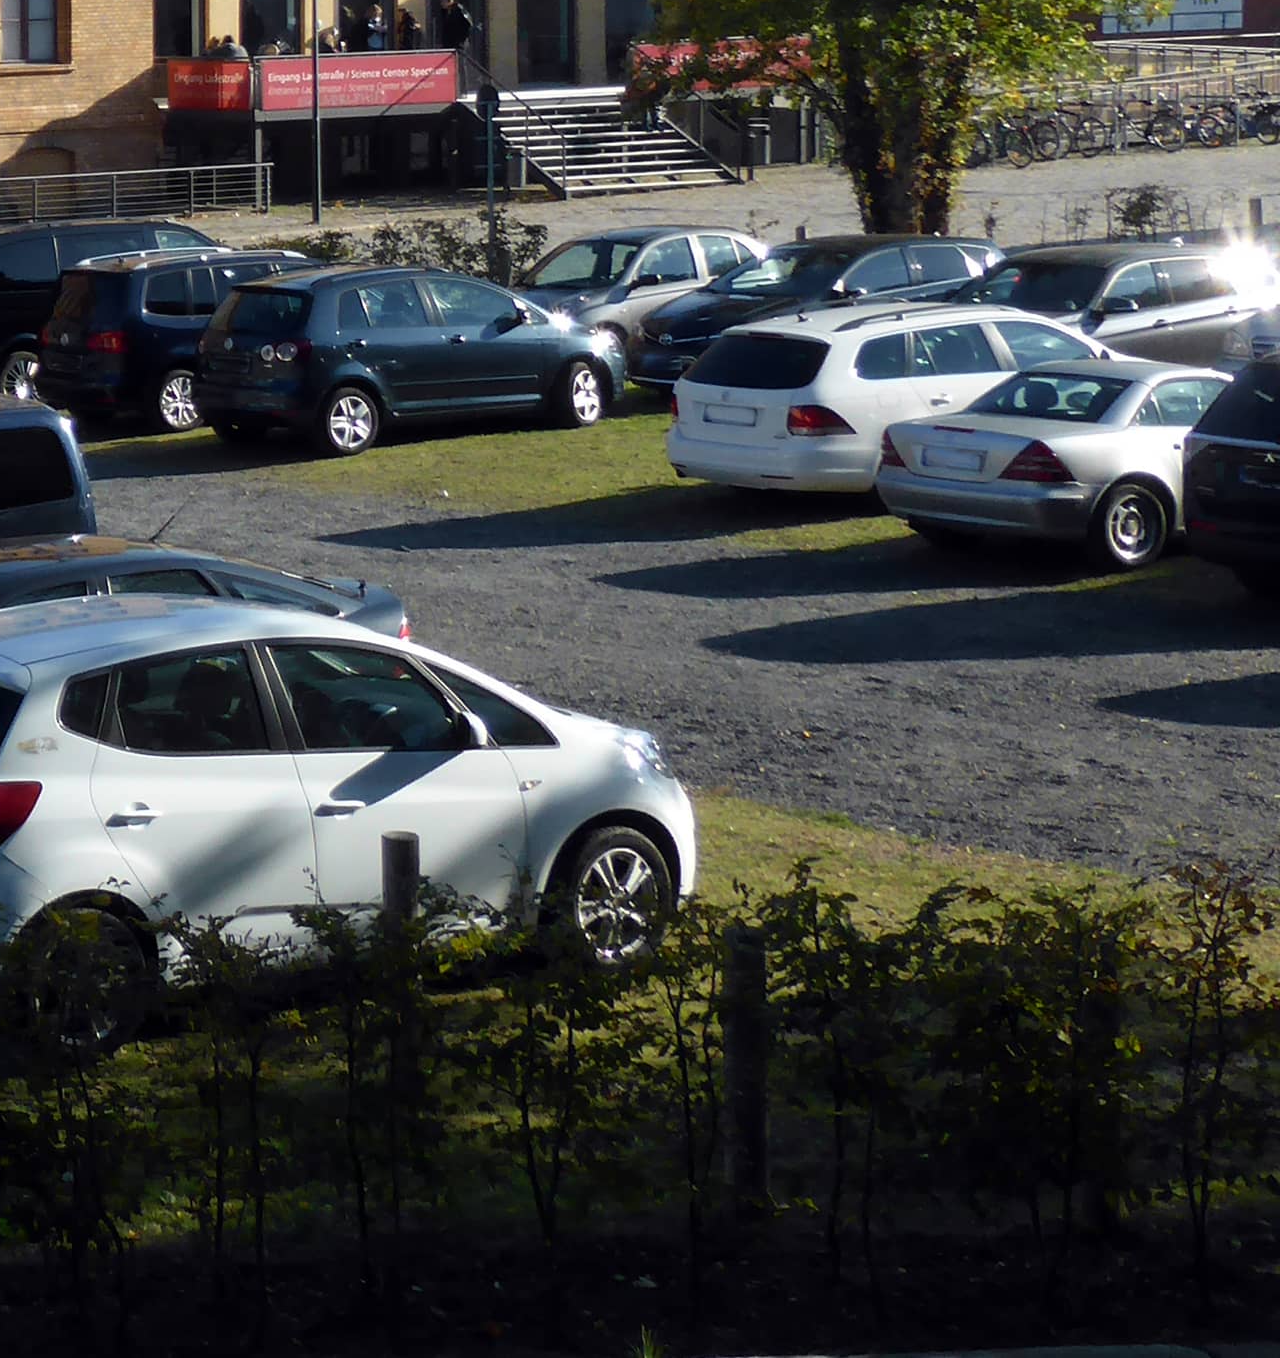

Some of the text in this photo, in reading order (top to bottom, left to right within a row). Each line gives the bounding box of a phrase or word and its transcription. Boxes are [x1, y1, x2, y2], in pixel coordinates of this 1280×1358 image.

[268, 73, 301, 84] Eingang
[302, 70, 345, 81] Lastraße
[351, 69, 380, 79] Science
[382, 68, 409, 78] Center
